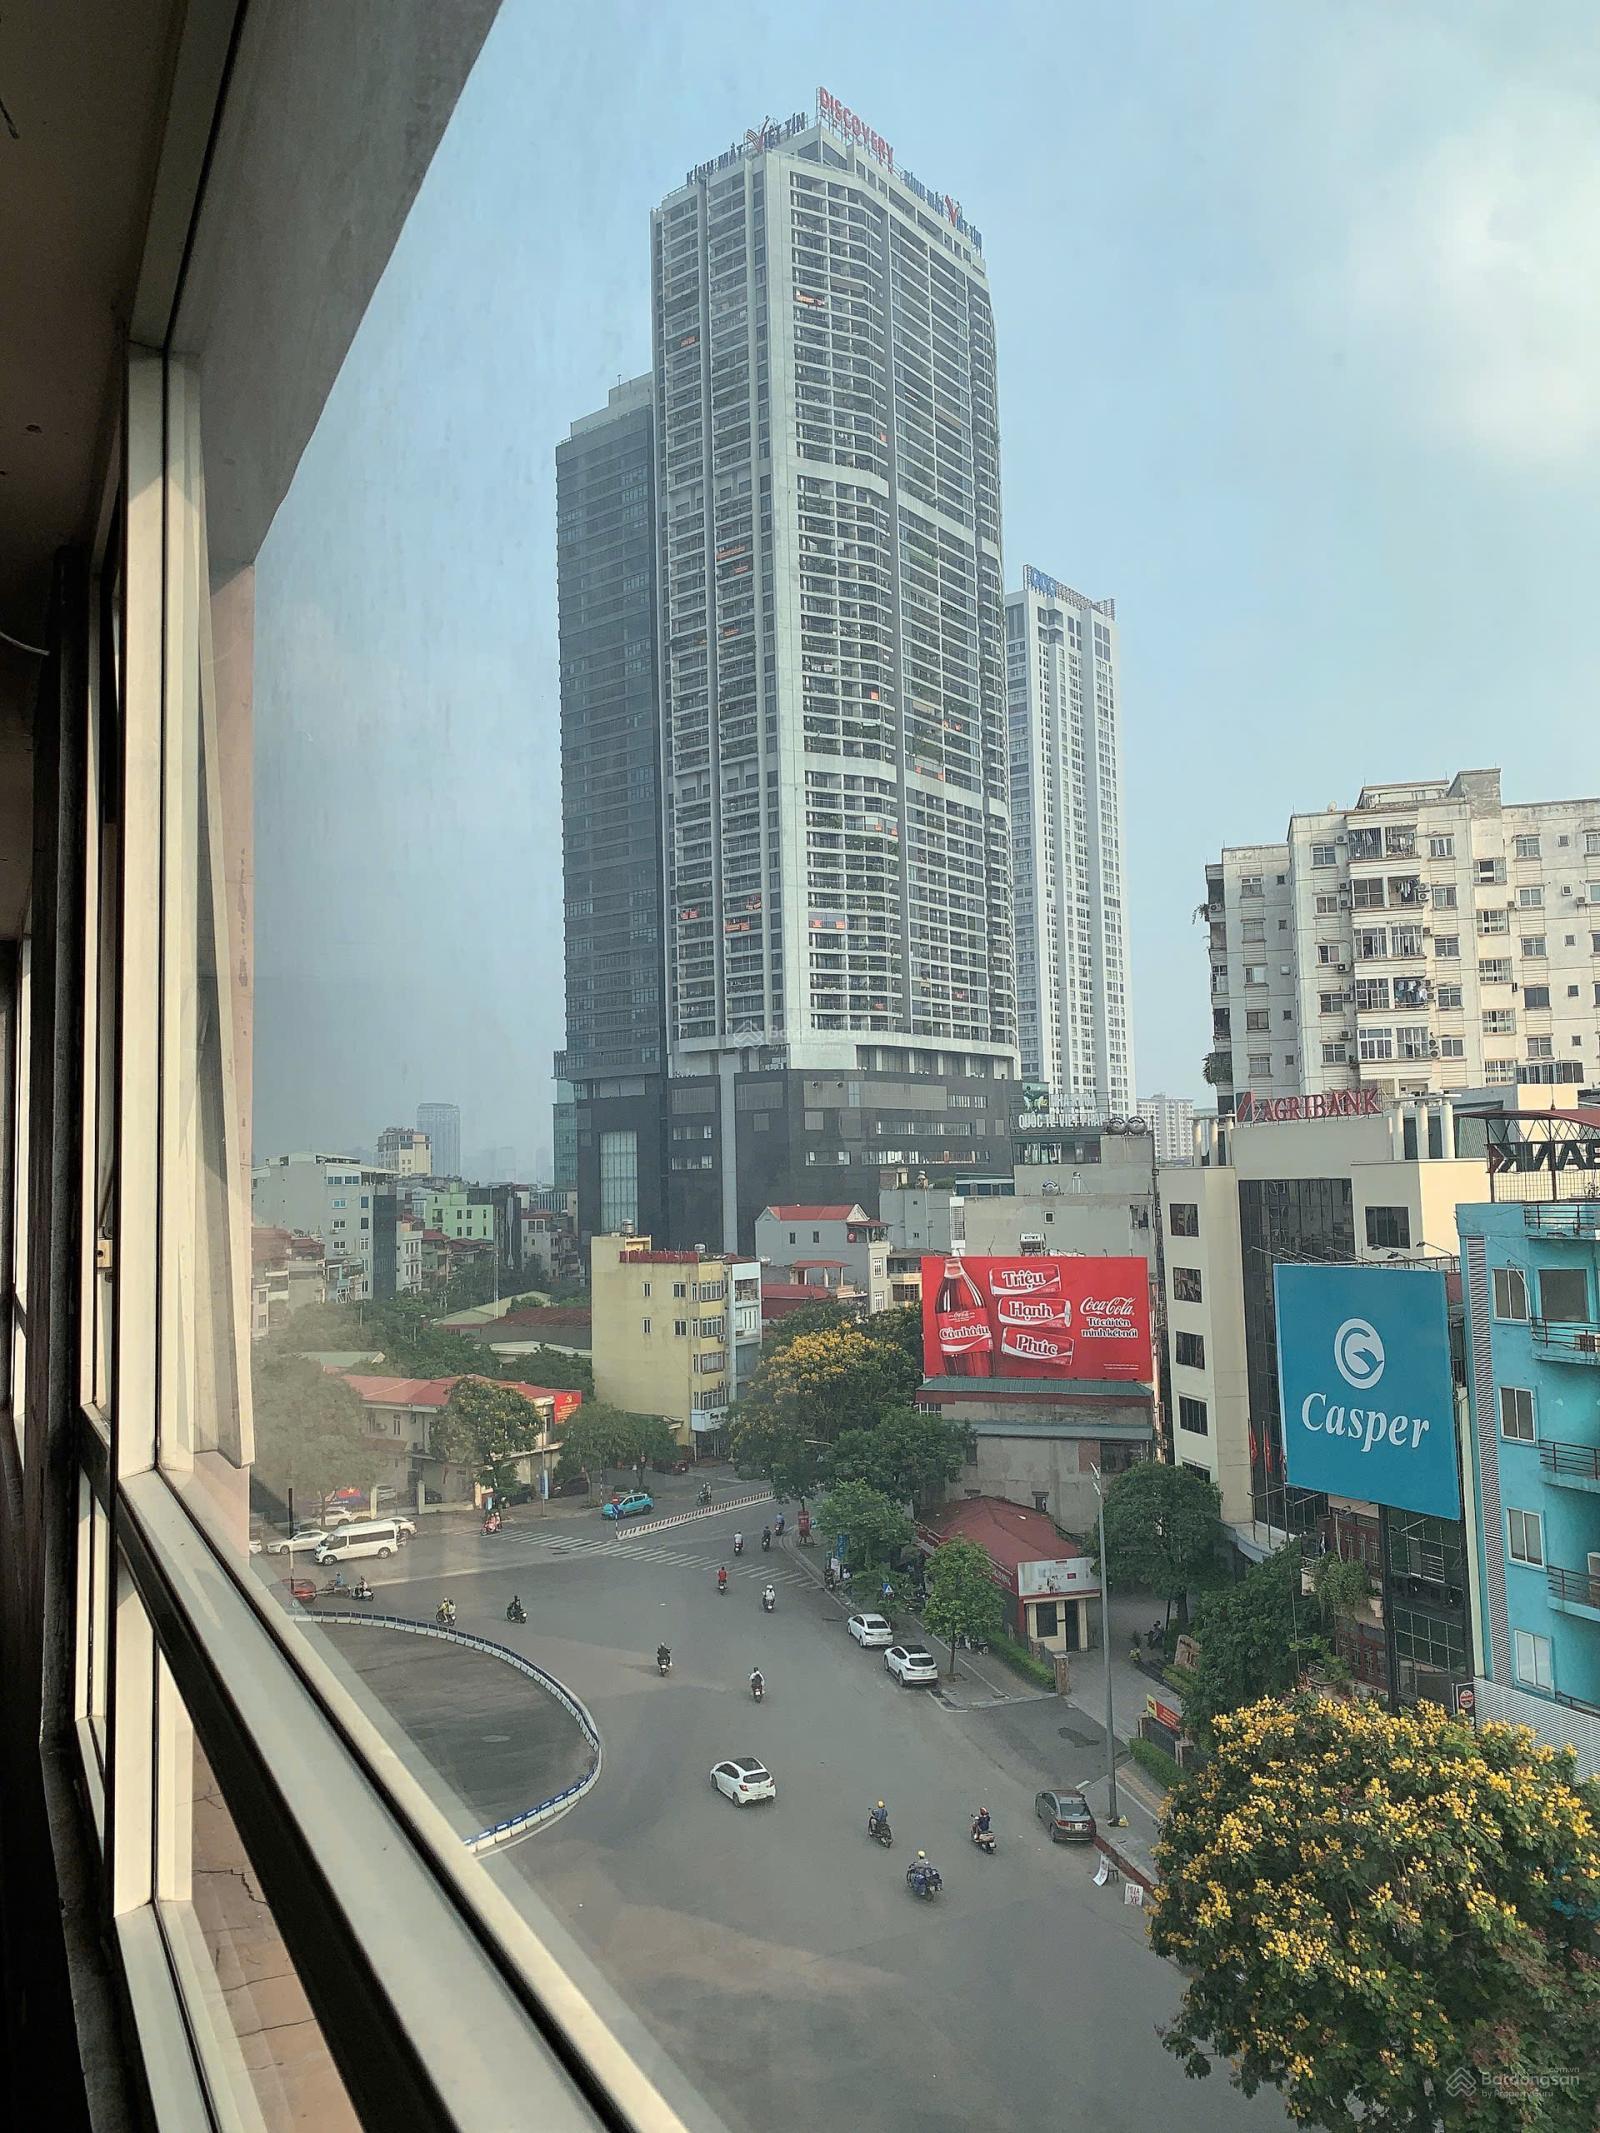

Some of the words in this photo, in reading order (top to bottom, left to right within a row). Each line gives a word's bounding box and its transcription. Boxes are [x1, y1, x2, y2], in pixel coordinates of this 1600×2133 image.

[819, 86, 894, 165] DISCOVERY
[1263, 1088, 1382, 1121] AGRIBANK
[1002, 1270, 1046, 1289] Triệu
[1009, 1301, 1053, 1321] Hạnh
[1016, 1334, 1058, 1356] Phúc
[1302, 1392, 1430, 1452] Casper
